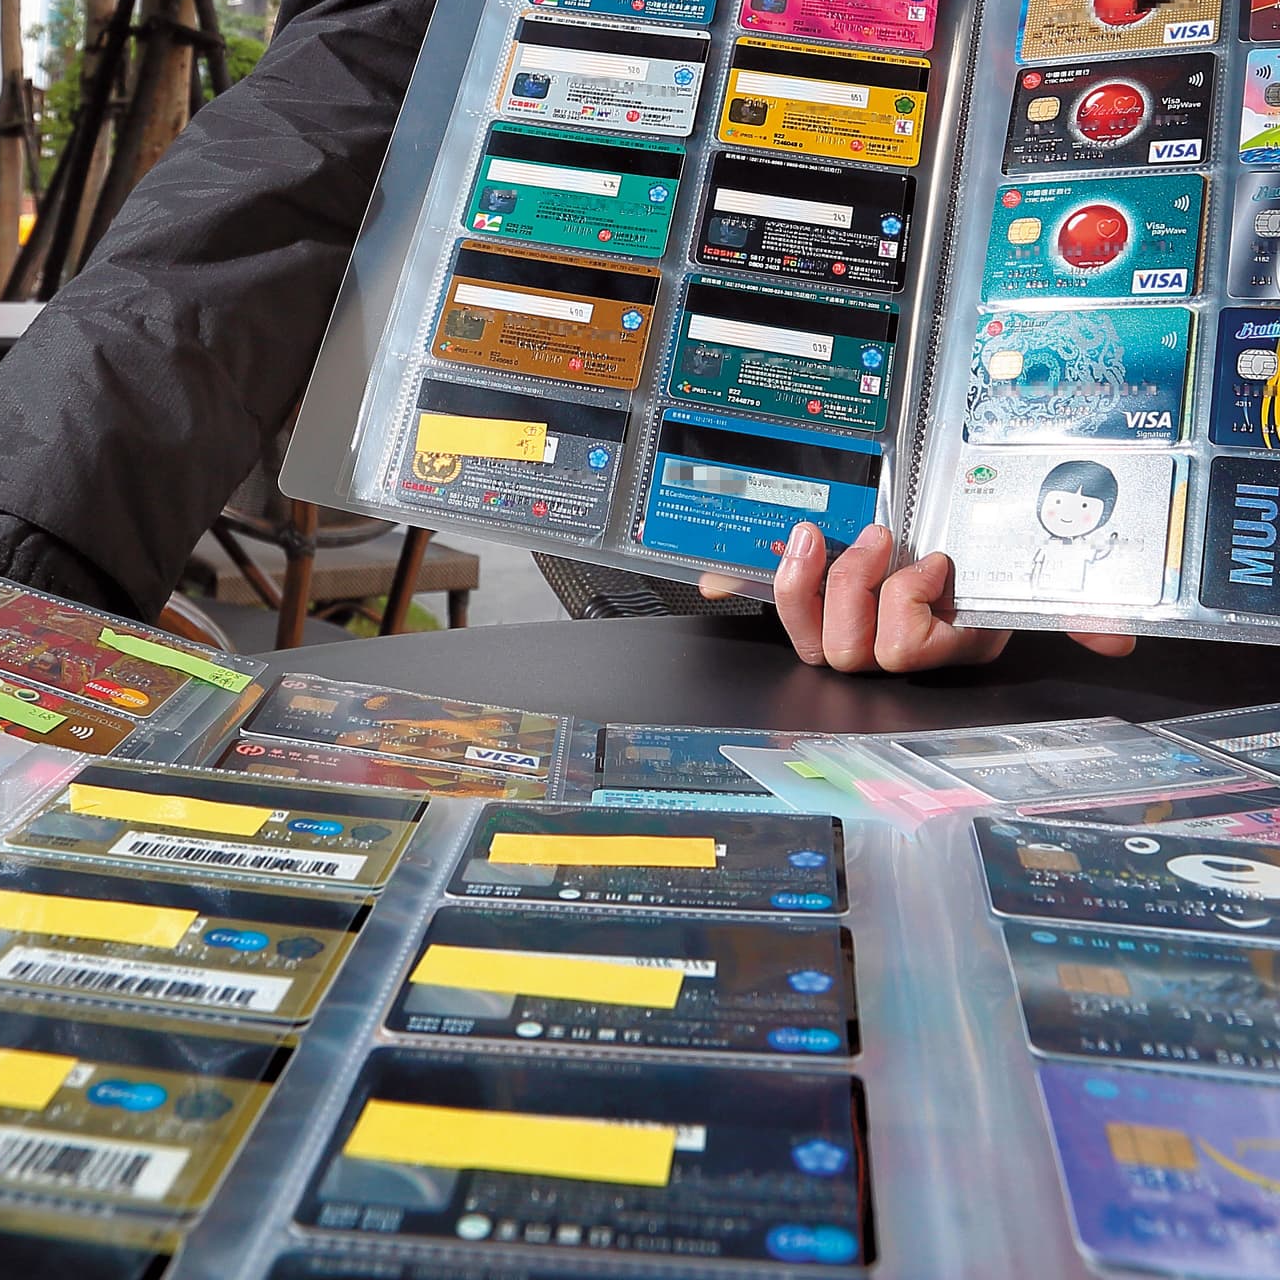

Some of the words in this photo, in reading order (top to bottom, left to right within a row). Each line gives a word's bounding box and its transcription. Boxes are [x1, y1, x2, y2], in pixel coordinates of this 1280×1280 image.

[1170, 24, 1211, 39] VISA
[1162, 97, 1181, 105] Visa
[1167, 101, 1202, 110] payWave
[1154, 143, 1199, 159] VISA
[1146, 222, 1166, 231] Visa
[1151, 227, 1187, 236] payWave
[1138, 272, 1184, 289] VISA
[1124, 411, 1172, 429] VISA
[1136, 430, 1171, 439] Signature
[1228, 483, 1280, 587] MUJI
[86, 680, 147, 706] MasterCard
[314, 758, 338, 767] BANK
[470, 750, 539, 767] VISA
[294, 822, 336, 832] Cirrus
